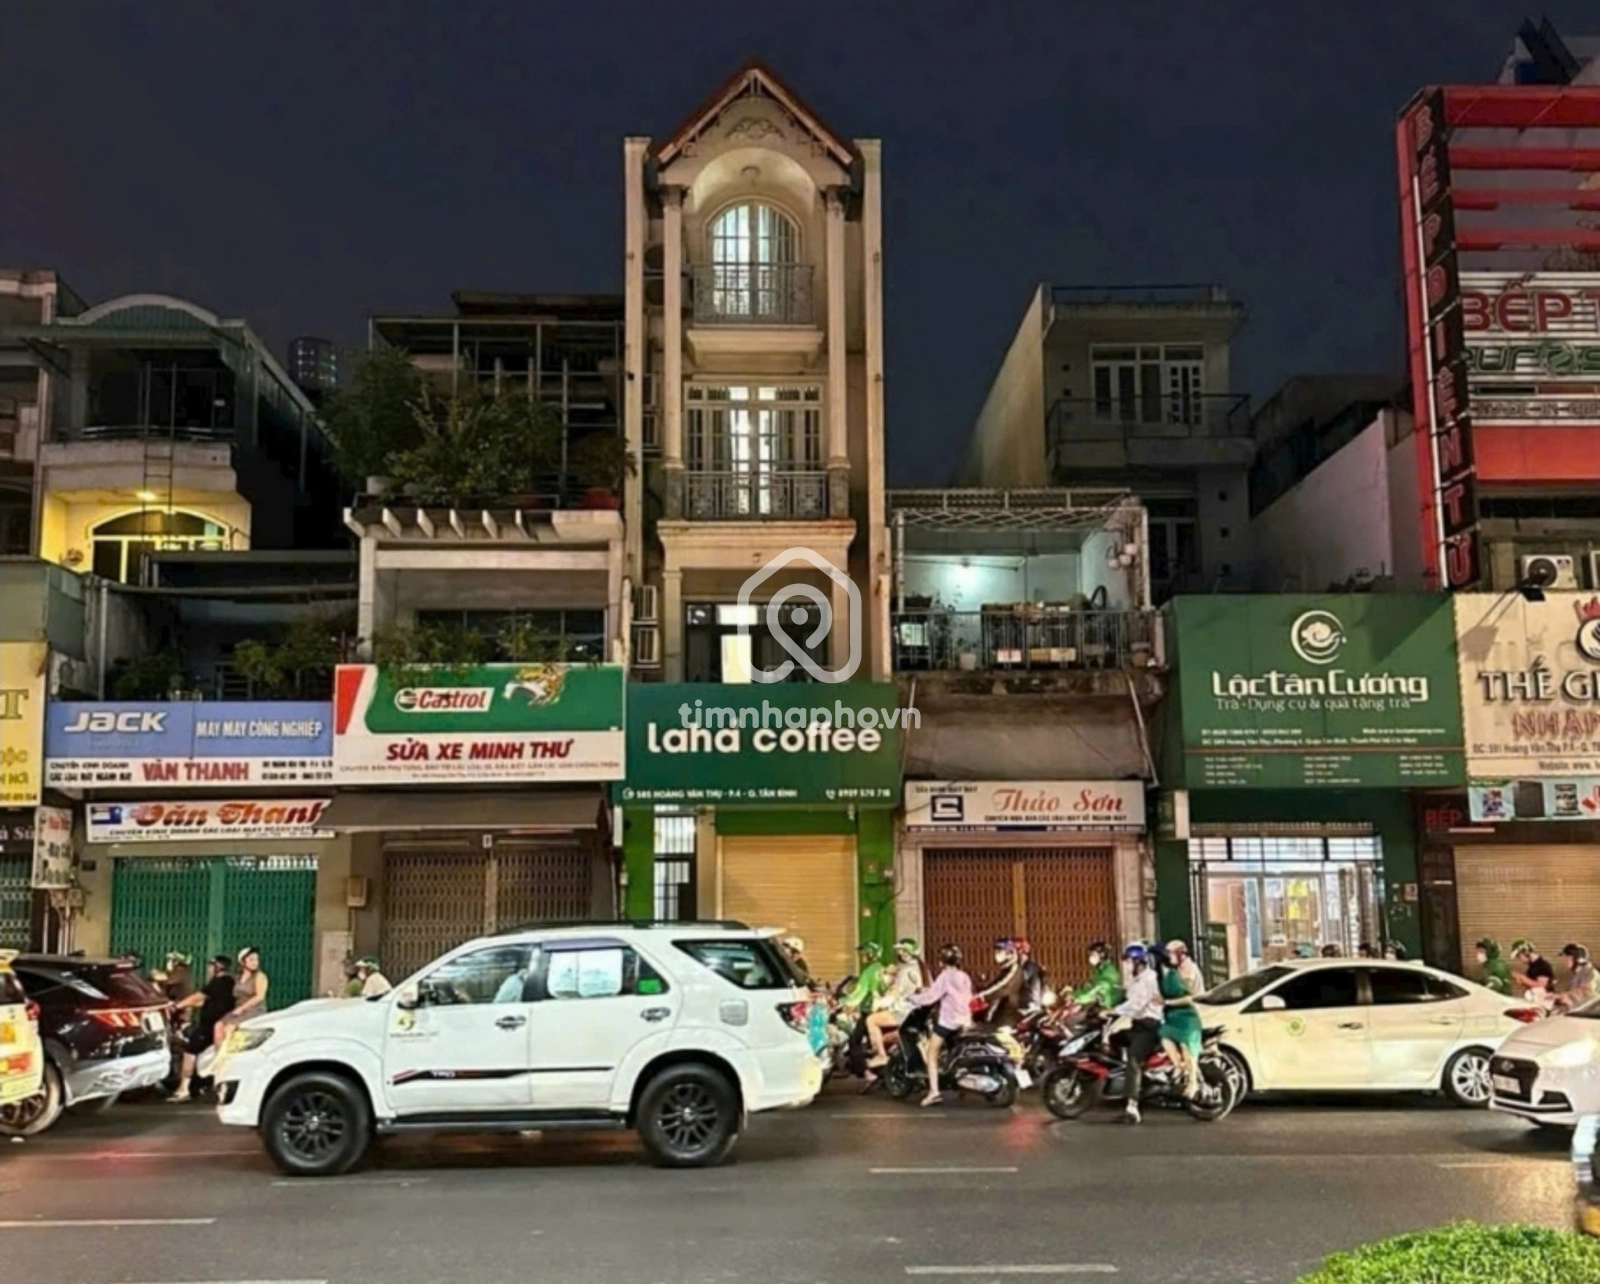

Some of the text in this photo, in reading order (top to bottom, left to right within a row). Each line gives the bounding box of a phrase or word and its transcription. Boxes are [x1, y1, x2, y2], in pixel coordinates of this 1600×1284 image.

[419, 690, 487, 708] Castrol
[753, 719, 882, 753] coffee
[386, 738, 574, 760] SỬA XE MINH THƯ
[142, 759, 249, 781] VĂN THANH
[993, 789, 1123, 812] Thảo Sơn
